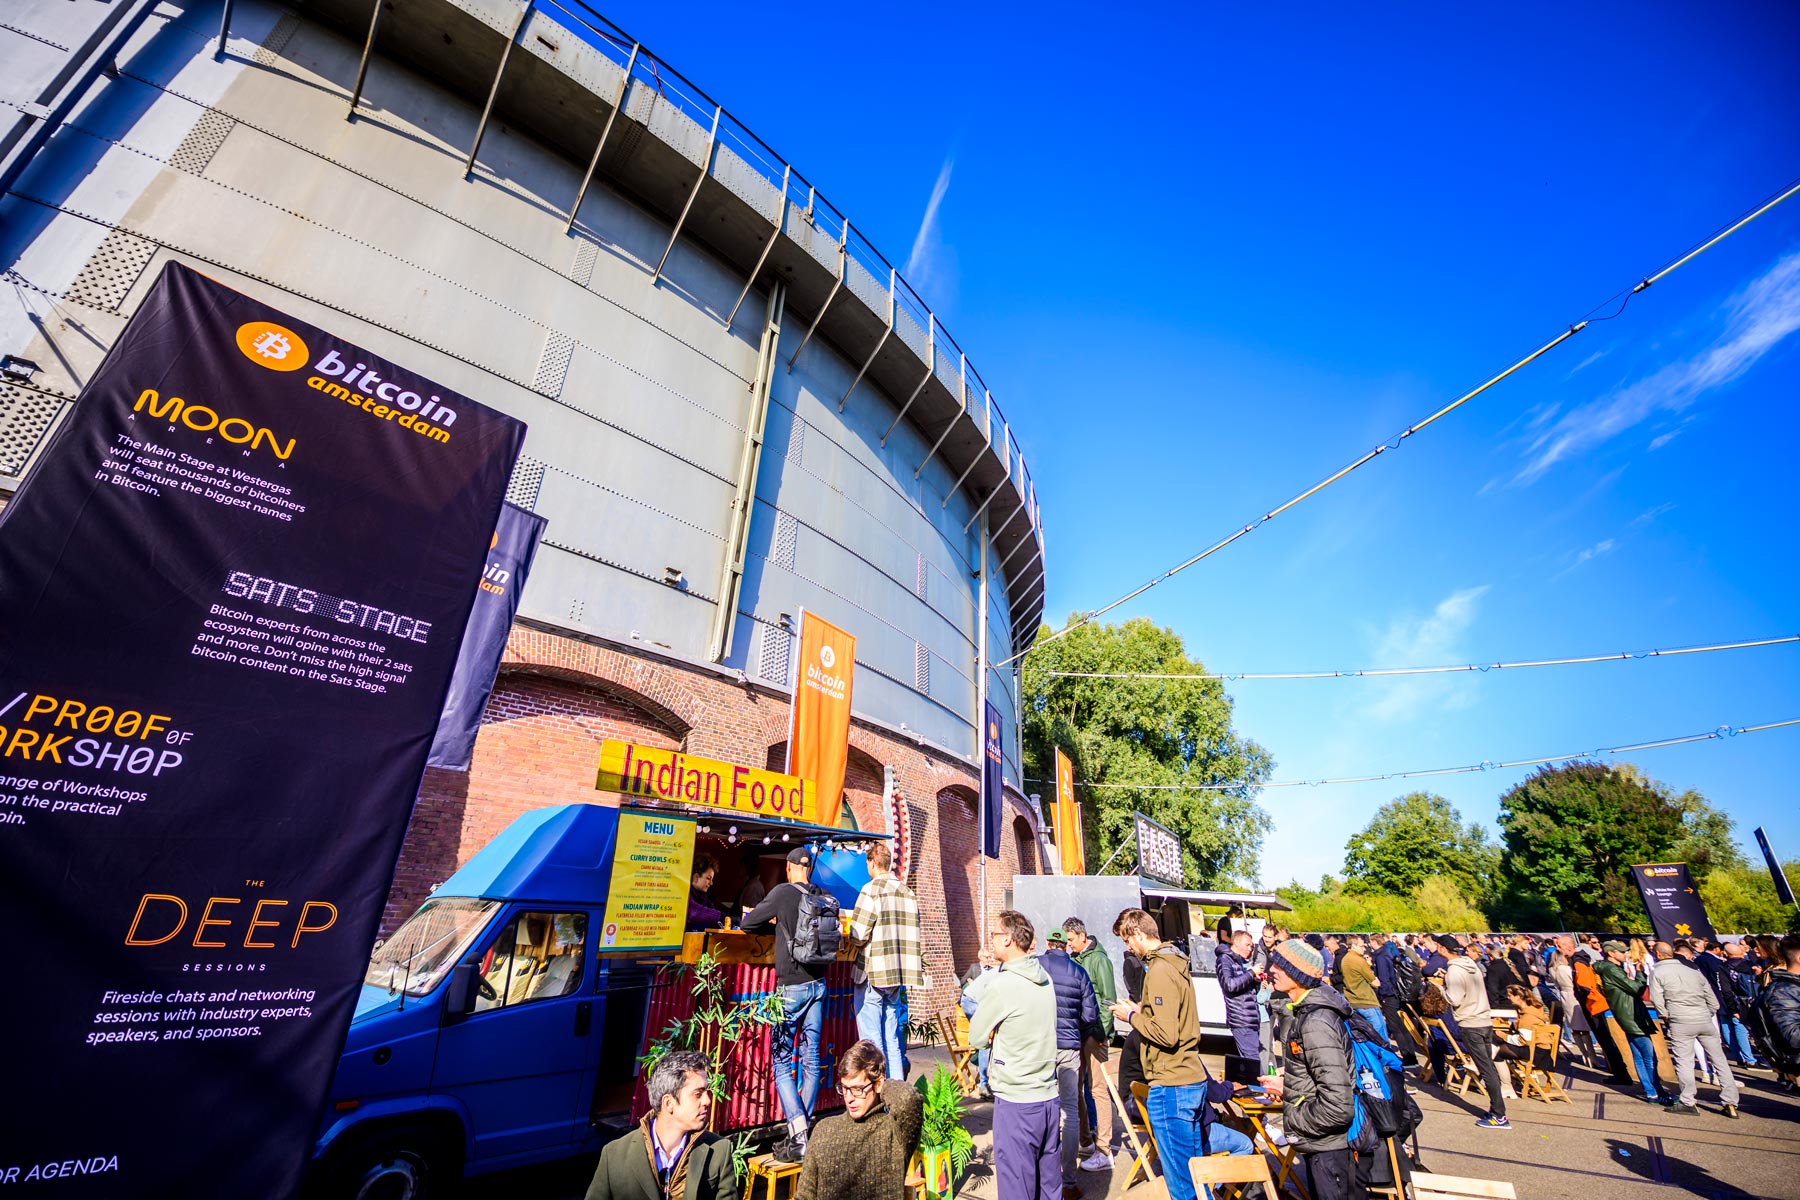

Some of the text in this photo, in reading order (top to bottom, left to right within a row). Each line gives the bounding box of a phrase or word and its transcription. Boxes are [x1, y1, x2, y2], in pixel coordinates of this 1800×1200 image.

[313, 350, 458, 429] bitcoin
[133, 389, 297, 460] MOON
[306, 376, 451, 444] amsterdam
[117, 433, 292, 496] The Main Stage at Westergas
[94, 469, 161, 497] in Bitcoin.
[101, 458, 293, 522] and feature the biggest names
[109, 446, 306, 513] will seat thousands of bitcoiners
[223, 571, 432, 644] SATS STAGE
[209, 603, 386, 653] Bitcoin experts from across the
[197, 631, 406, 685] and more. Don't miss the high signal
[203, 618, 413, 673] ecosystem will opine with their 2 sats
[191, 644, 387, 694] bitcoin content on the Sats Stage.
[807, 663, 845, 691] bitcoin
[806, 679, 845, 700] amsterdam
[41, 779, 63, 792] of
[63, 780, 148, 802] Workshops
[620, 744, 804, 817] Indian Food
[21, 794, 50, 809] the
[51, 799, 122, 816] practical
[644, 821, 674, 836] MENU
[630, 854, 648, 862] CURRY
[648, 855, 667, 863] BOWLS
[245, 879, 265, 888] THE
[124, 893, 339, 948] DEEP
[623, 903, 643, 911] INDIAN
[182, 963, 268, 972] SESSIONS
[101, 987, 315, 1004] Fireside chats and networking
[93, 1005, 313, 1024] sessions with industry experts,
[86, 1024, 262, 1046] speakers, and sponsors.
[0, 1155, 118, 1184] R AGENDA
